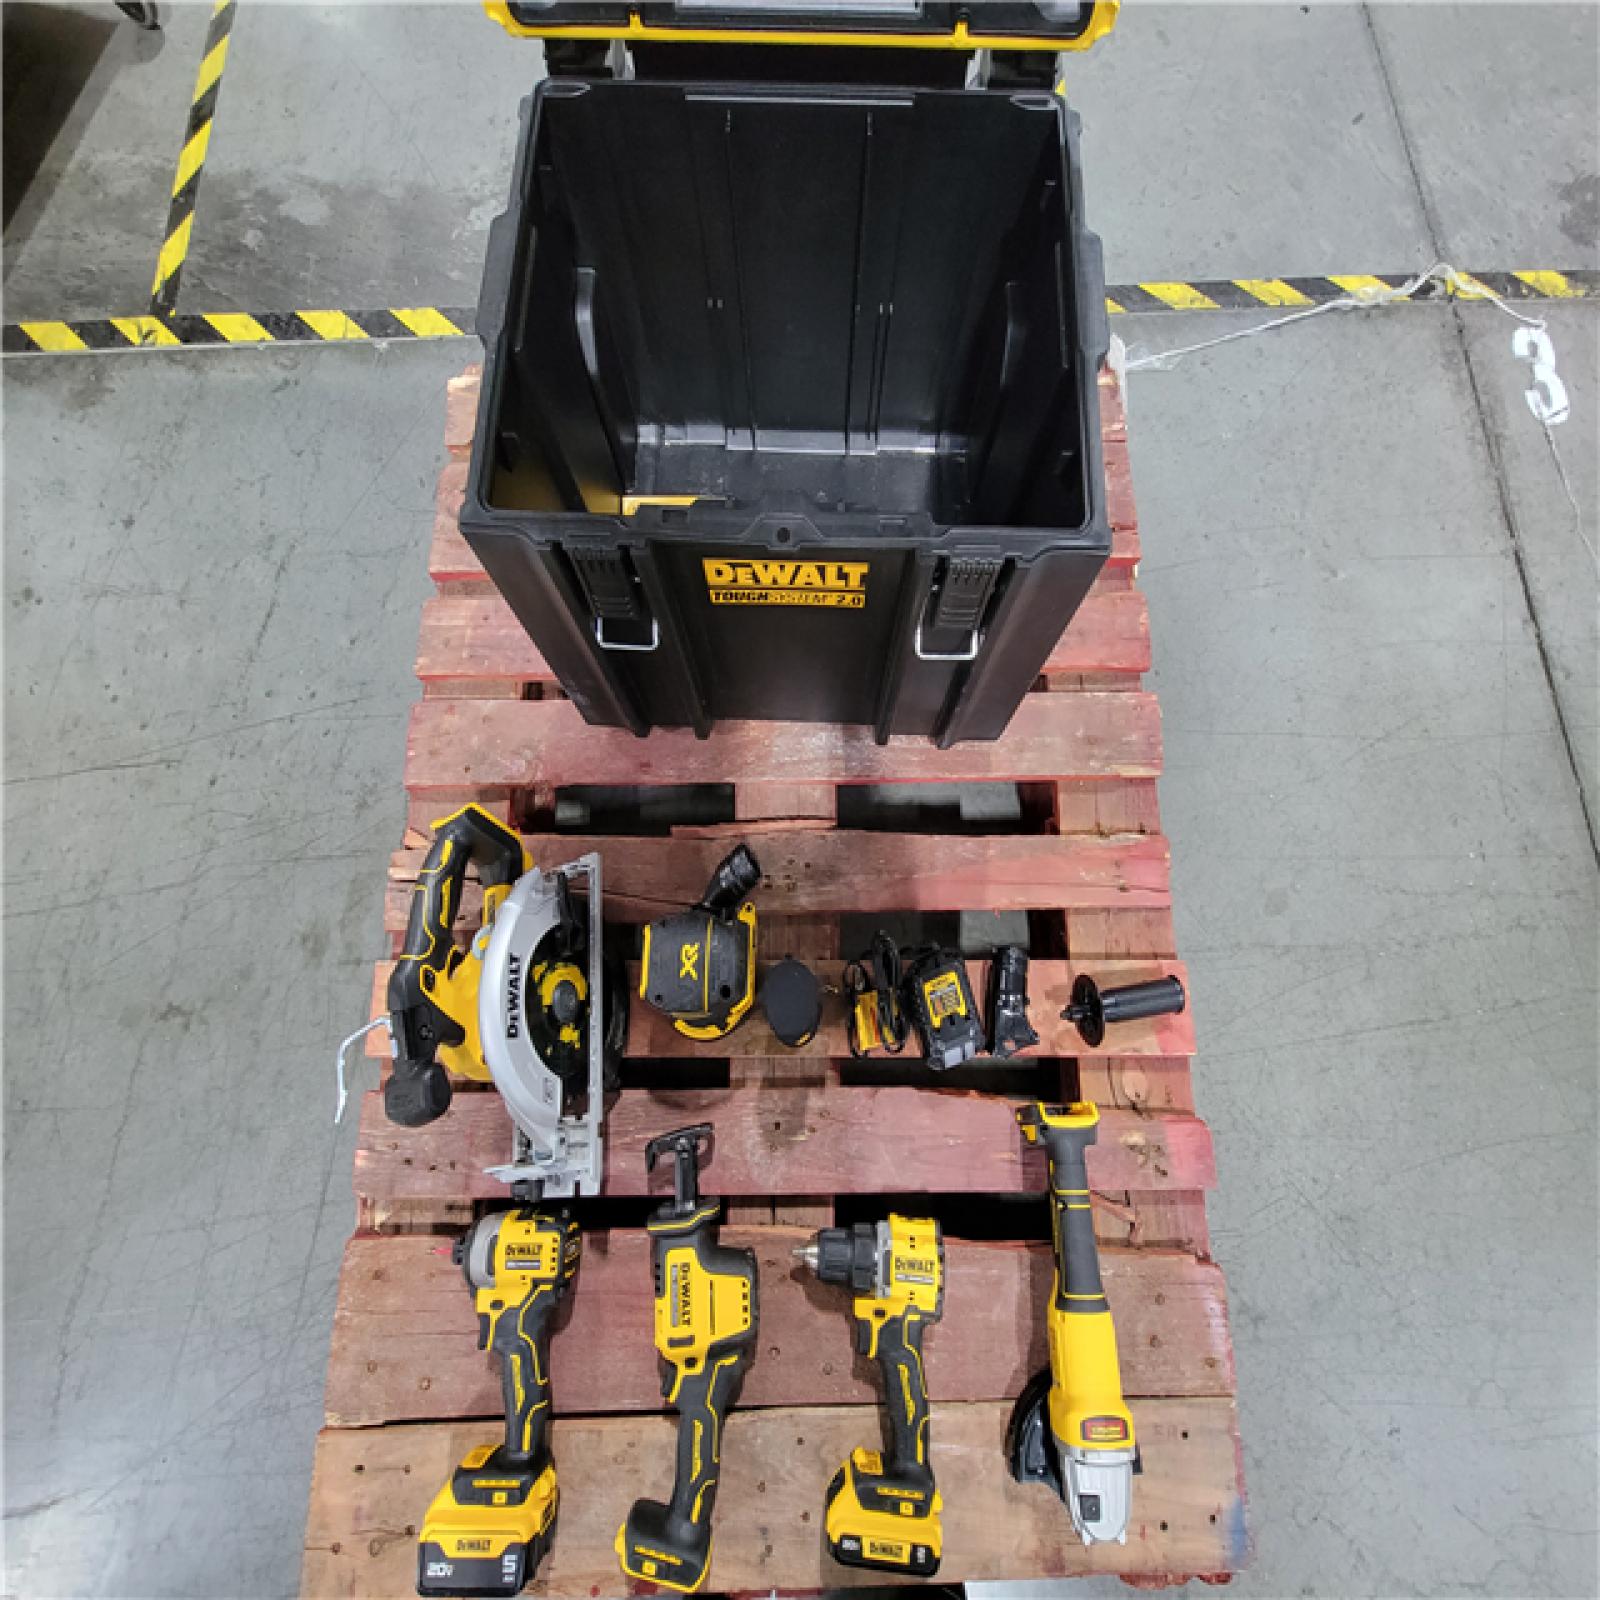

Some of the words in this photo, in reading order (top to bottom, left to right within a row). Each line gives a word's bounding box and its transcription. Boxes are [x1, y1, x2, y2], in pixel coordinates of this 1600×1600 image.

[1513, 328, 1568, 425] 3
[704, 559, 869, 589] DEWALT
[507, 952, 520, 1038] DEWALT
[680, 1262, 691, 1325] DEWALT
[502, 1554, 518, 1574] 5
